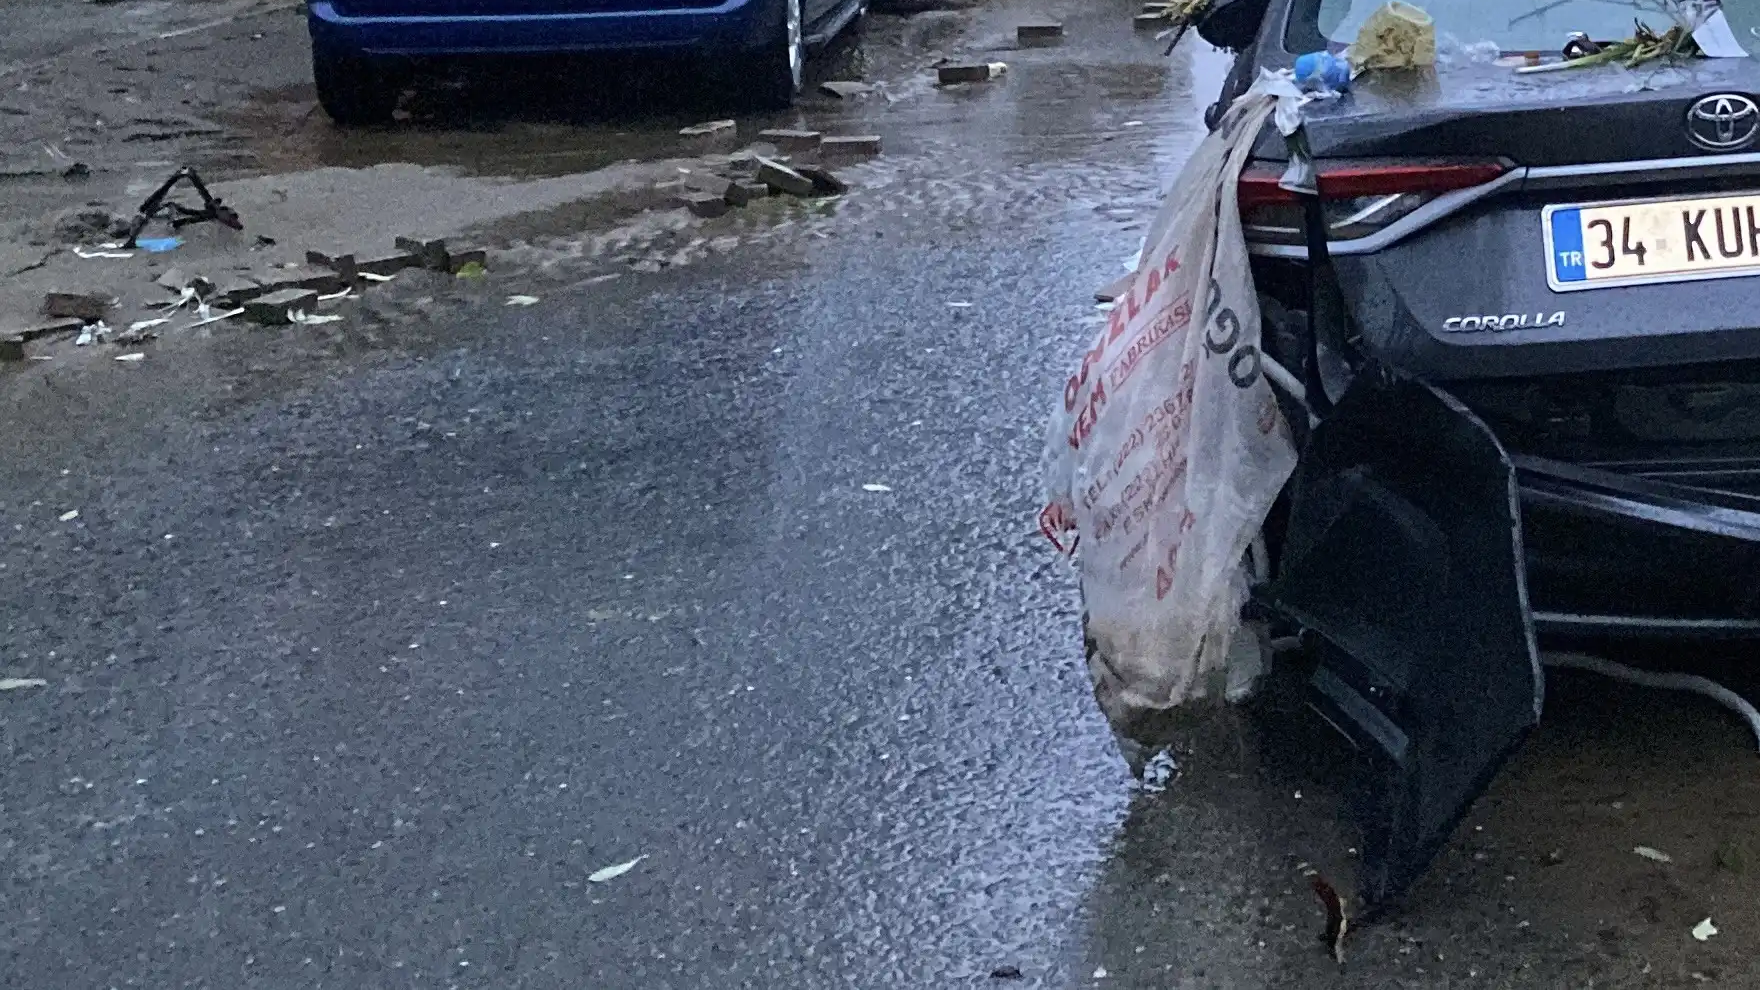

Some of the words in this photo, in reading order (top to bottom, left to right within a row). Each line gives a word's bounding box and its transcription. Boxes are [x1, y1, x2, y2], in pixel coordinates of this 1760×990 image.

[1559, 251, 1582, 267] TR
[1587, 216, 1647, 269] 34
[1442, 310, 1566, 331] COROLLA
